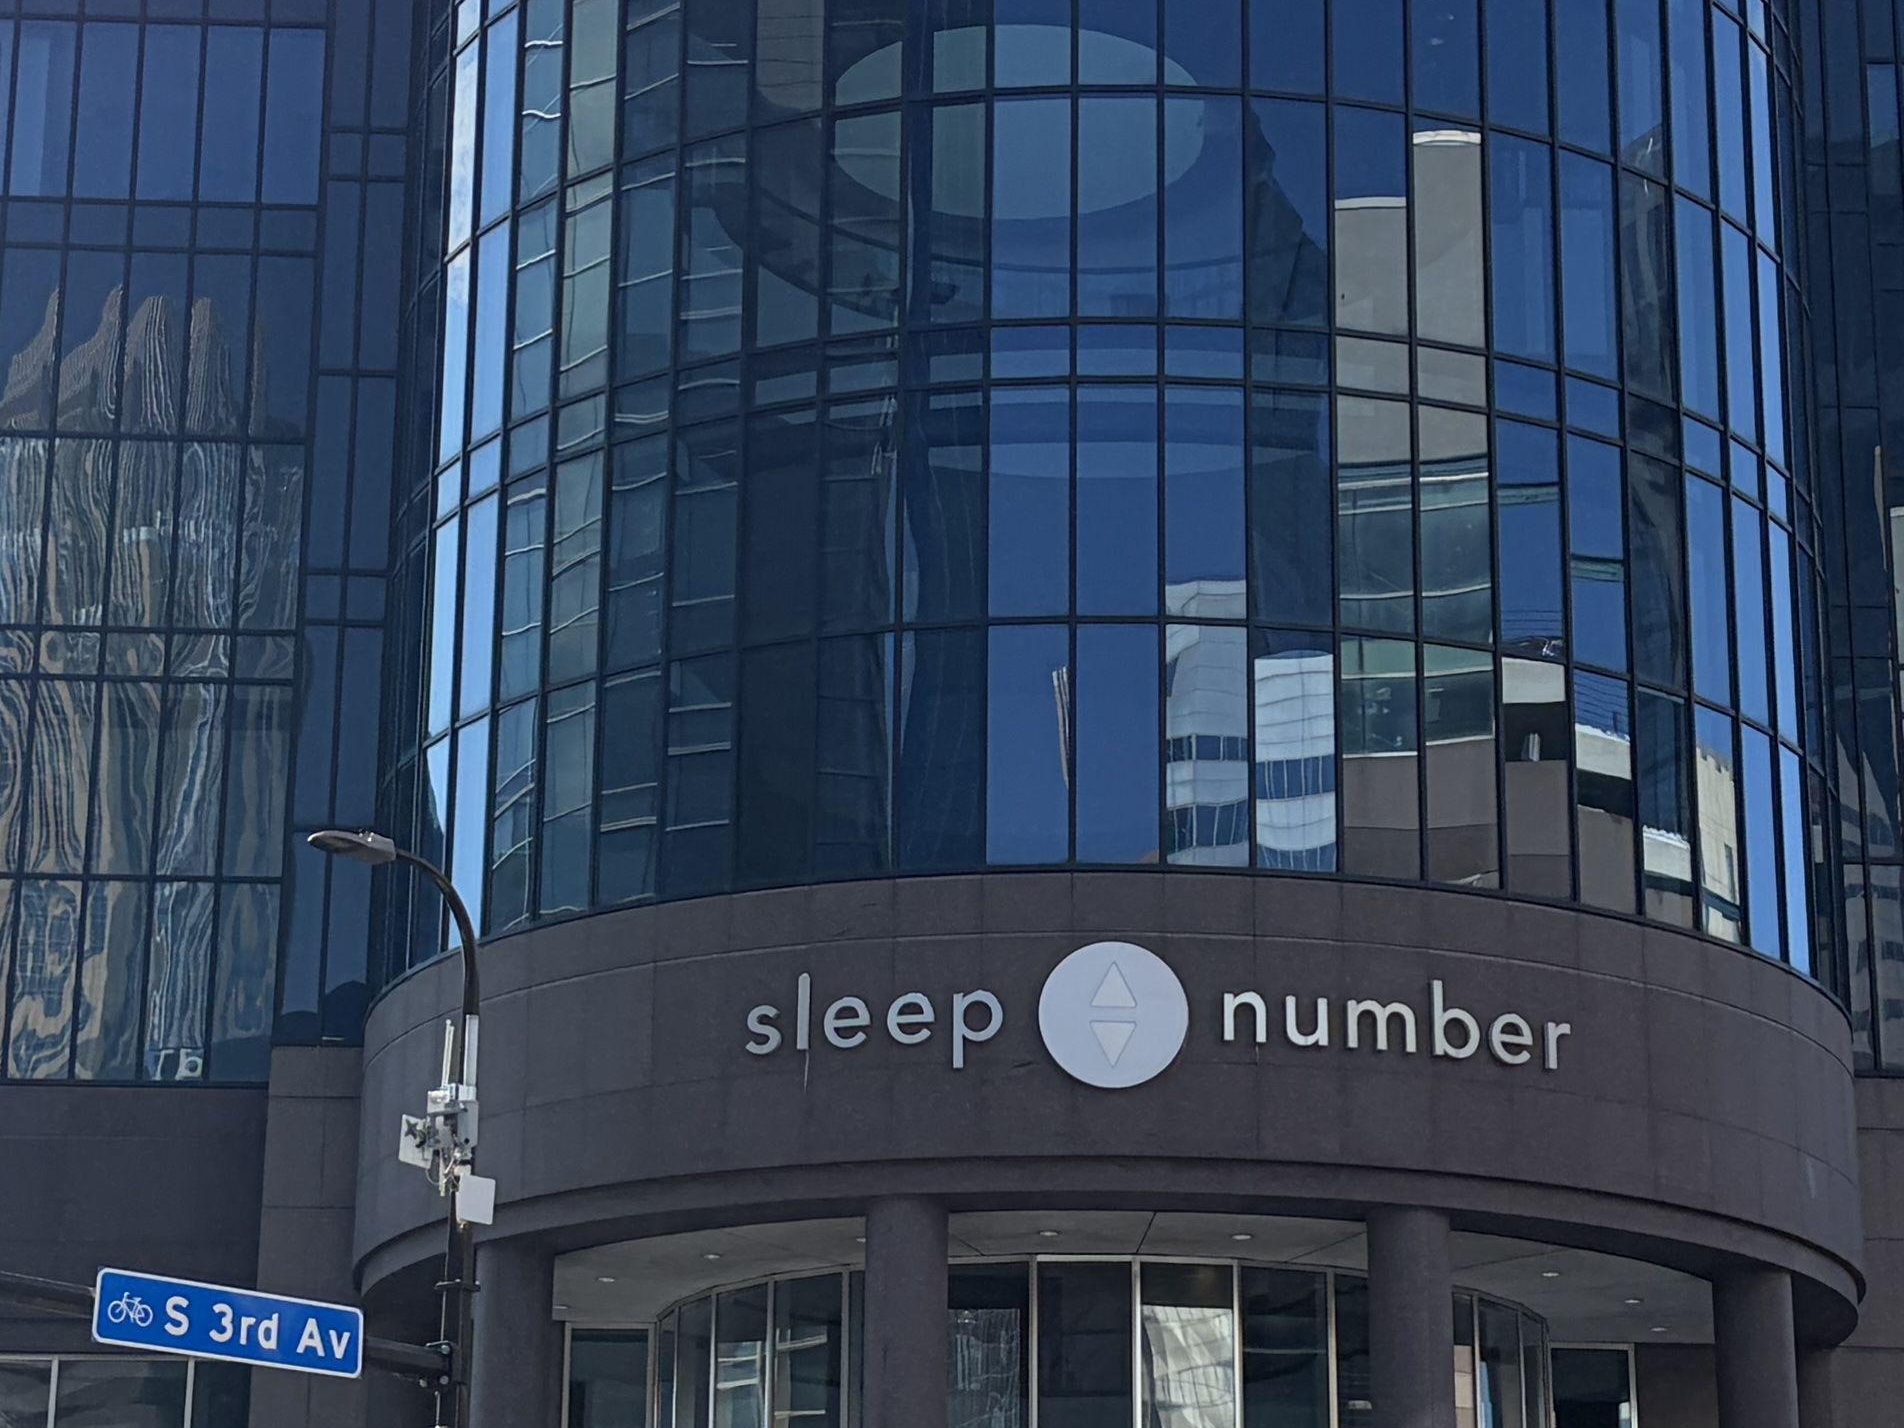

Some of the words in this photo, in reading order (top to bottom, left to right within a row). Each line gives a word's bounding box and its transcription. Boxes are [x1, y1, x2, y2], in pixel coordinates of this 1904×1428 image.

[745, 972, 1004, 1070] sleep
[1223, 978, 1571, 1070] number
[164, 1295, 190, 1337] S
[209, 1302, 280, 1351] 3rd
[296, 1317, 351, 1360] Av
